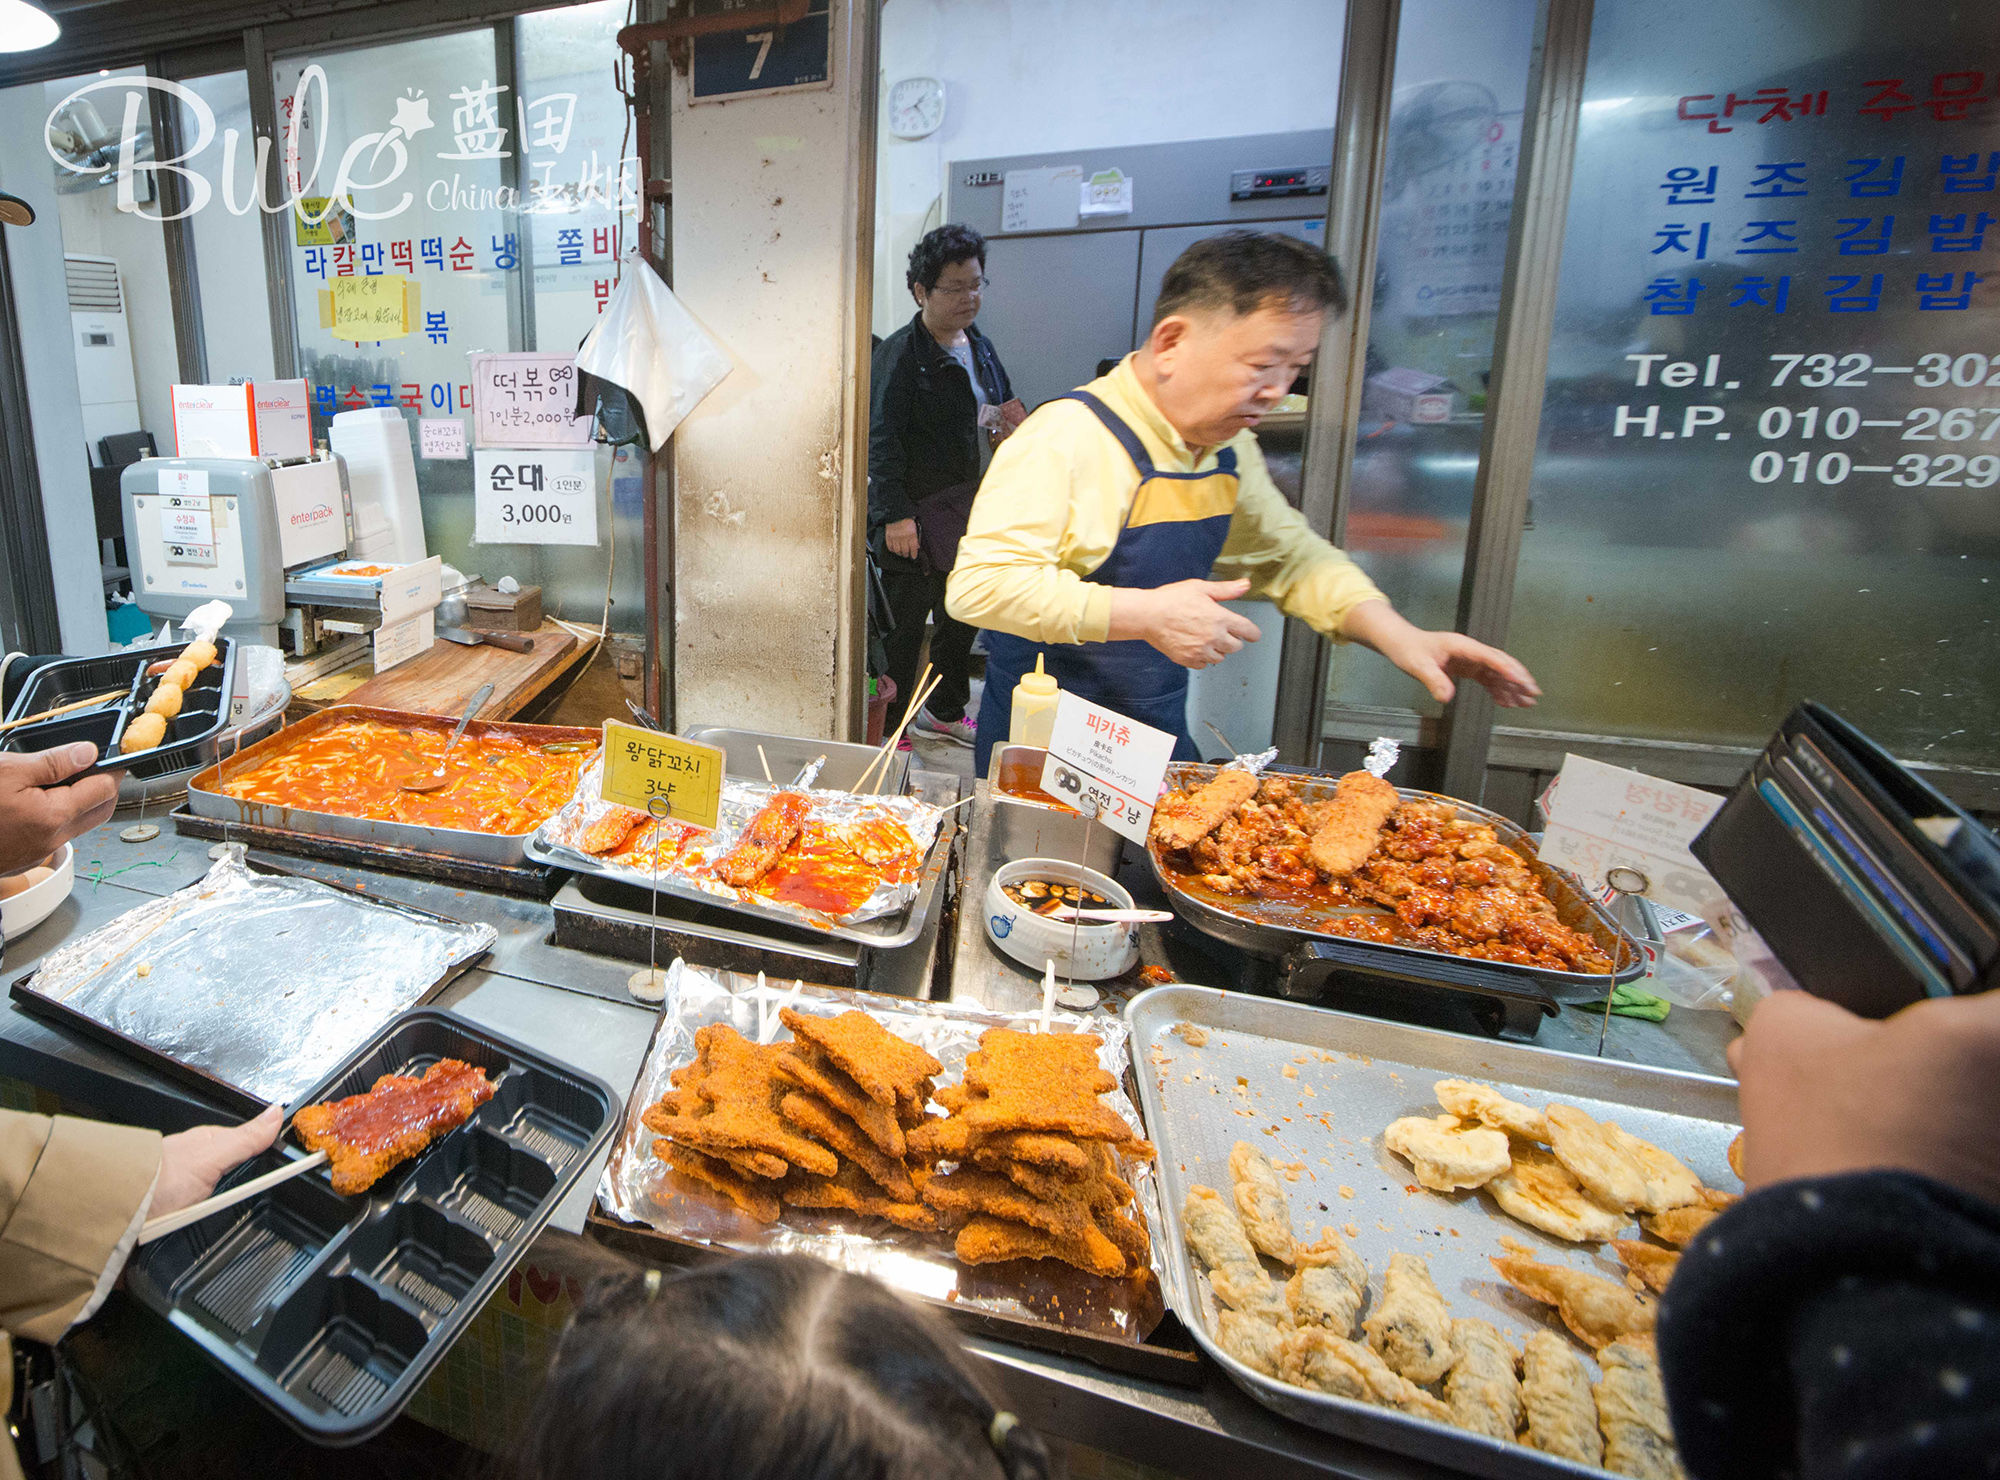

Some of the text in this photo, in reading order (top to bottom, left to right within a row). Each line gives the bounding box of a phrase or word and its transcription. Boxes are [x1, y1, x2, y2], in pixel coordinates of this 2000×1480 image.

[746, 31, 773, 80] 7
[1678, 72, 2000, 134] 단체 주문
[493, 366, 574, 402] 떡볶이
[1625, 354, 1741, 390] Tel.
[1613, 405, 1732, 441] H.P.
[490, 464, 584, 492] 순대 1인분
[176, 514, 196, 525] 수정과
[290, 505, 334, 526] enterpack
[502, 504, 573, 526] 3,000원
[1086, 712, 1132, 746] 피카츄
[625, 741, 701, 774] 왕닭꼬치
[1089, 748, 1113, 765] Pikachu
[644, 778, 677, 800] 3냥
